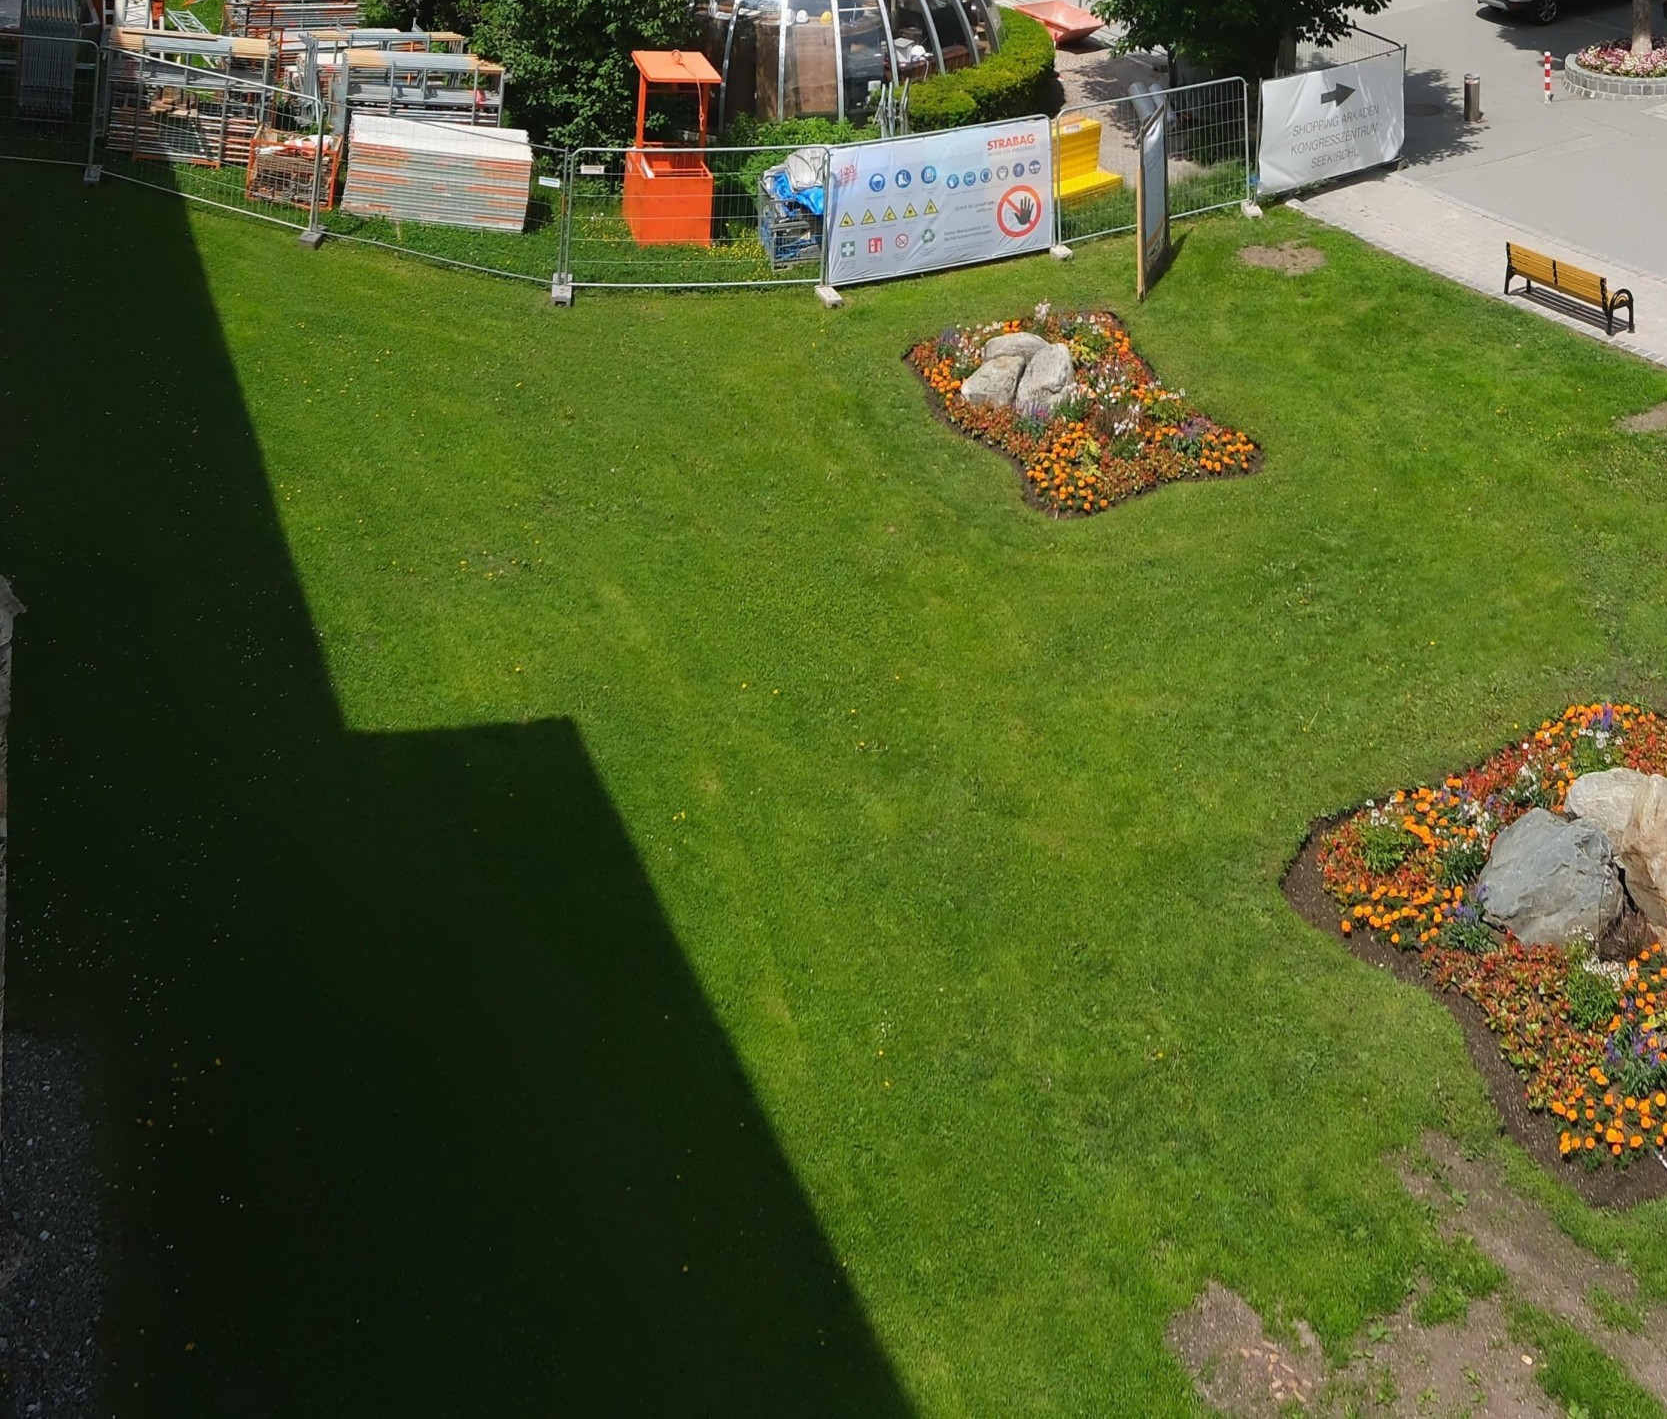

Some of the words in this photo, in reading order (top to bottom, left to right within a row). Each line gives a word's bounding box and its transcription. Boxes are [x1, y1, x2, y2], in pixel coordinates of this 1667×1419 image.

[1293, 115, 1339, 137] SHOPPING
[1341, 104, 1380, 123] ARKADEN
[987, 133, 1035, 150] STRABAG
[1290, 122, 1379, 156] KONGRESSZENTRUM
